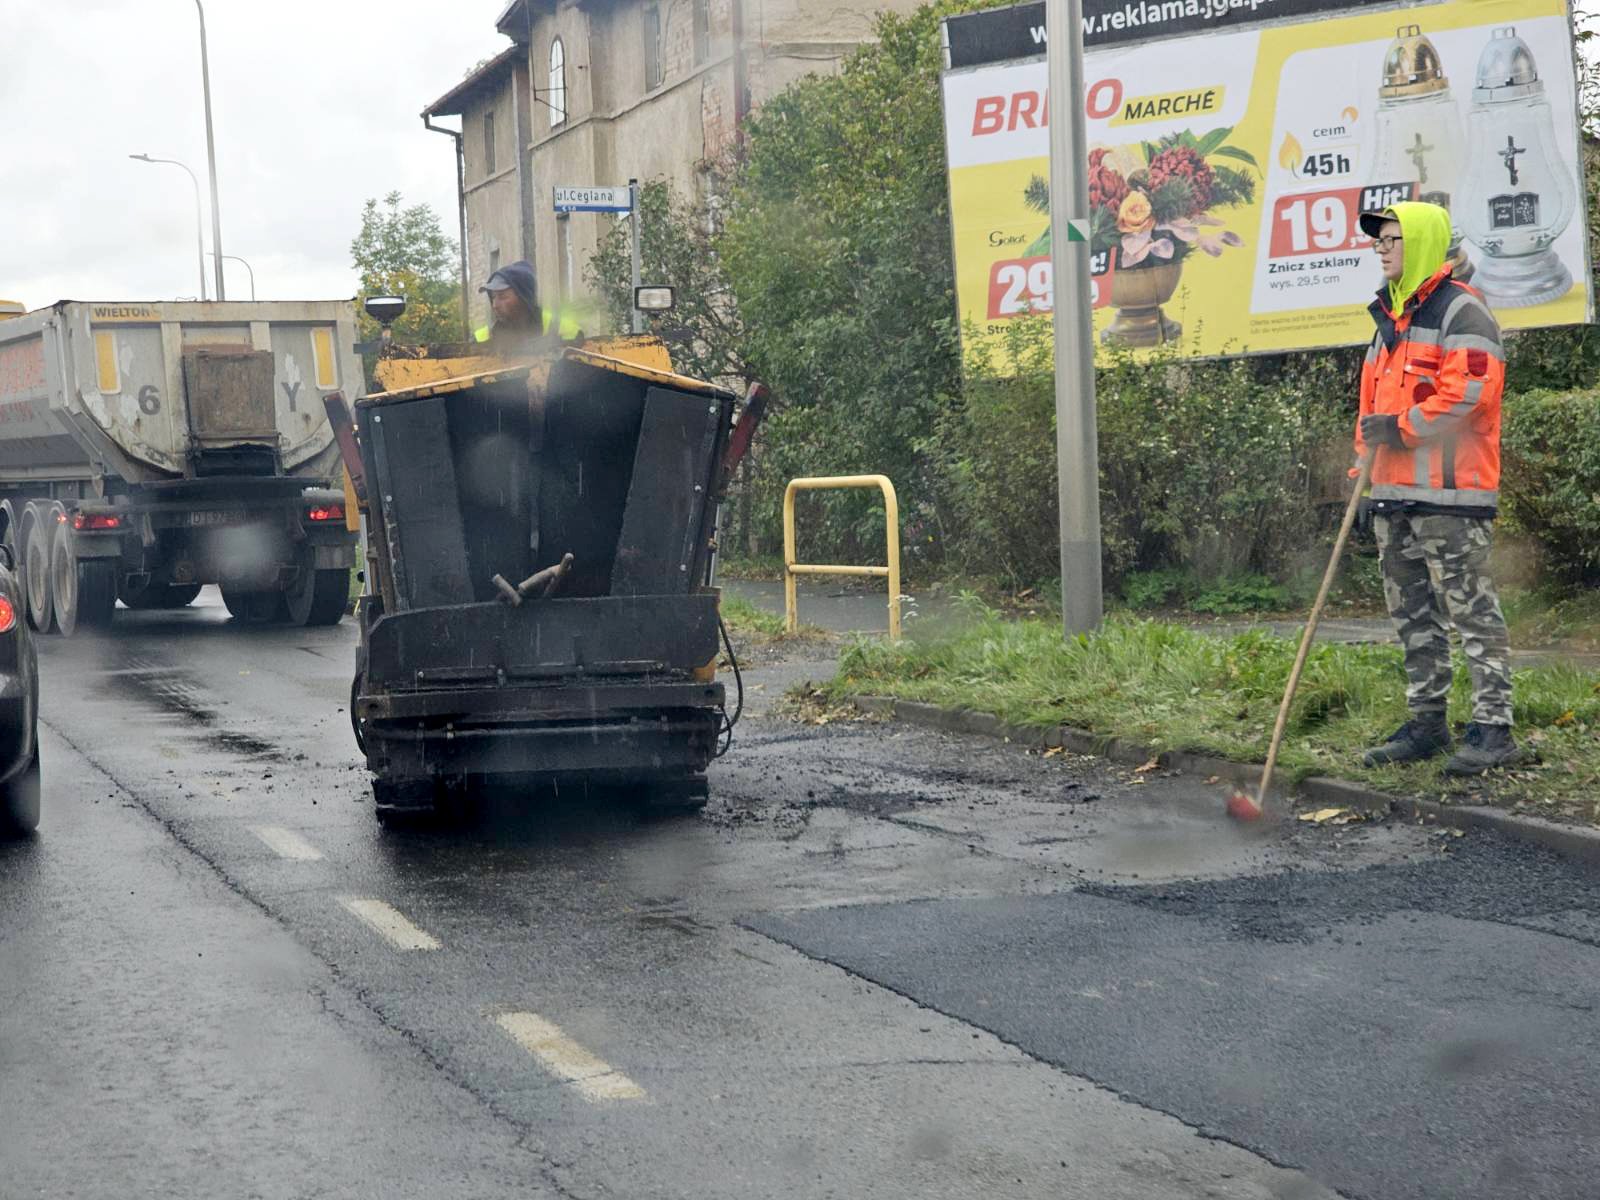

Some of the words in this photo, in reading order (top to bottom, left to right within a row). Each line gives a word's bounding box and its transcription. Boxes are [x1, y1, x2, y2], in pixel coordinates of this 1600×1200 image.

[1125, 90, 1216, 120] MARCHÉ
[1303, 153, 1350, 177] 45h
[1363, 186, 1409, 211] Hit!
[1269, 263, 1305, 274] Znicz
[1310, 256, 1361, 270] szklany
[1270, 278, 1294, 291] wys.
[1297, 274, 1321, 288] 29,5
[1323, 274, 1340, 284] cm
[138, 385, 161, 416] 6
[281, 382, 300, 412] Y
